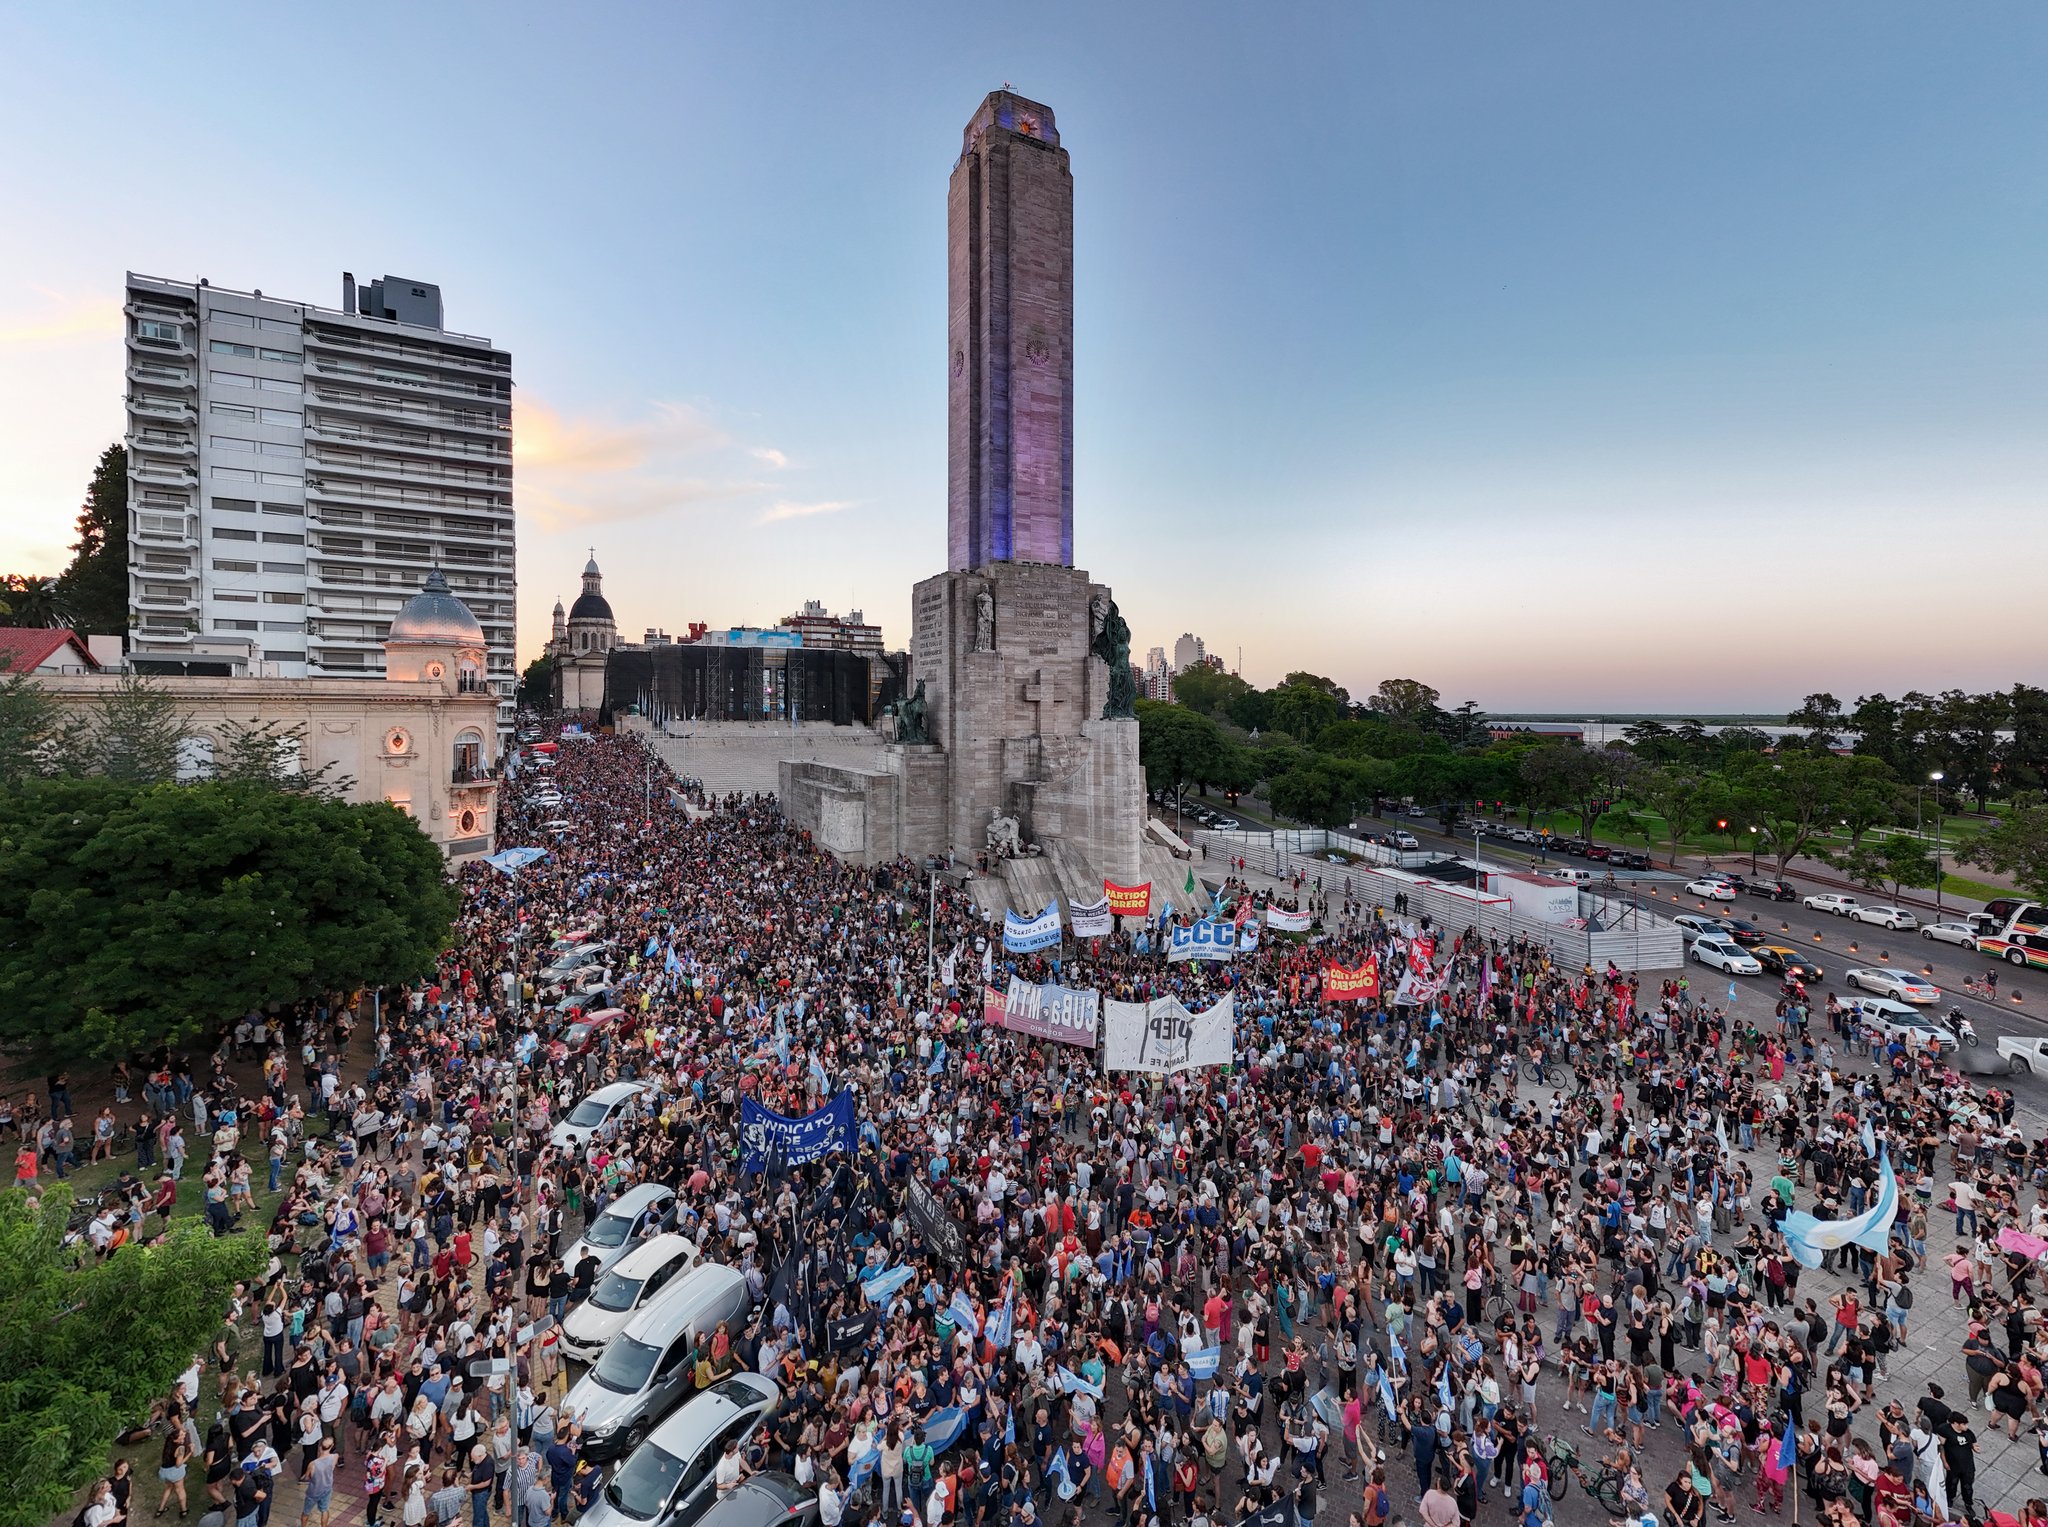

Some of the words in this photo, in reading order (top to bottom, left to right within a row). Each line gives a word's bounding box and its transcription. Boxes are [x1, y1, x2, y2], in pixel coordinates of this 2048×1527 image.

[1105, 888, 1148, 901] PARTIDO
[1029, 932, 1060, 946] UNILEVER
[1173, 920, 1234, 948] CCC
[755, 1112, 834, 1135] SINDICATO
[783, 1135, 801, 1146] DE
